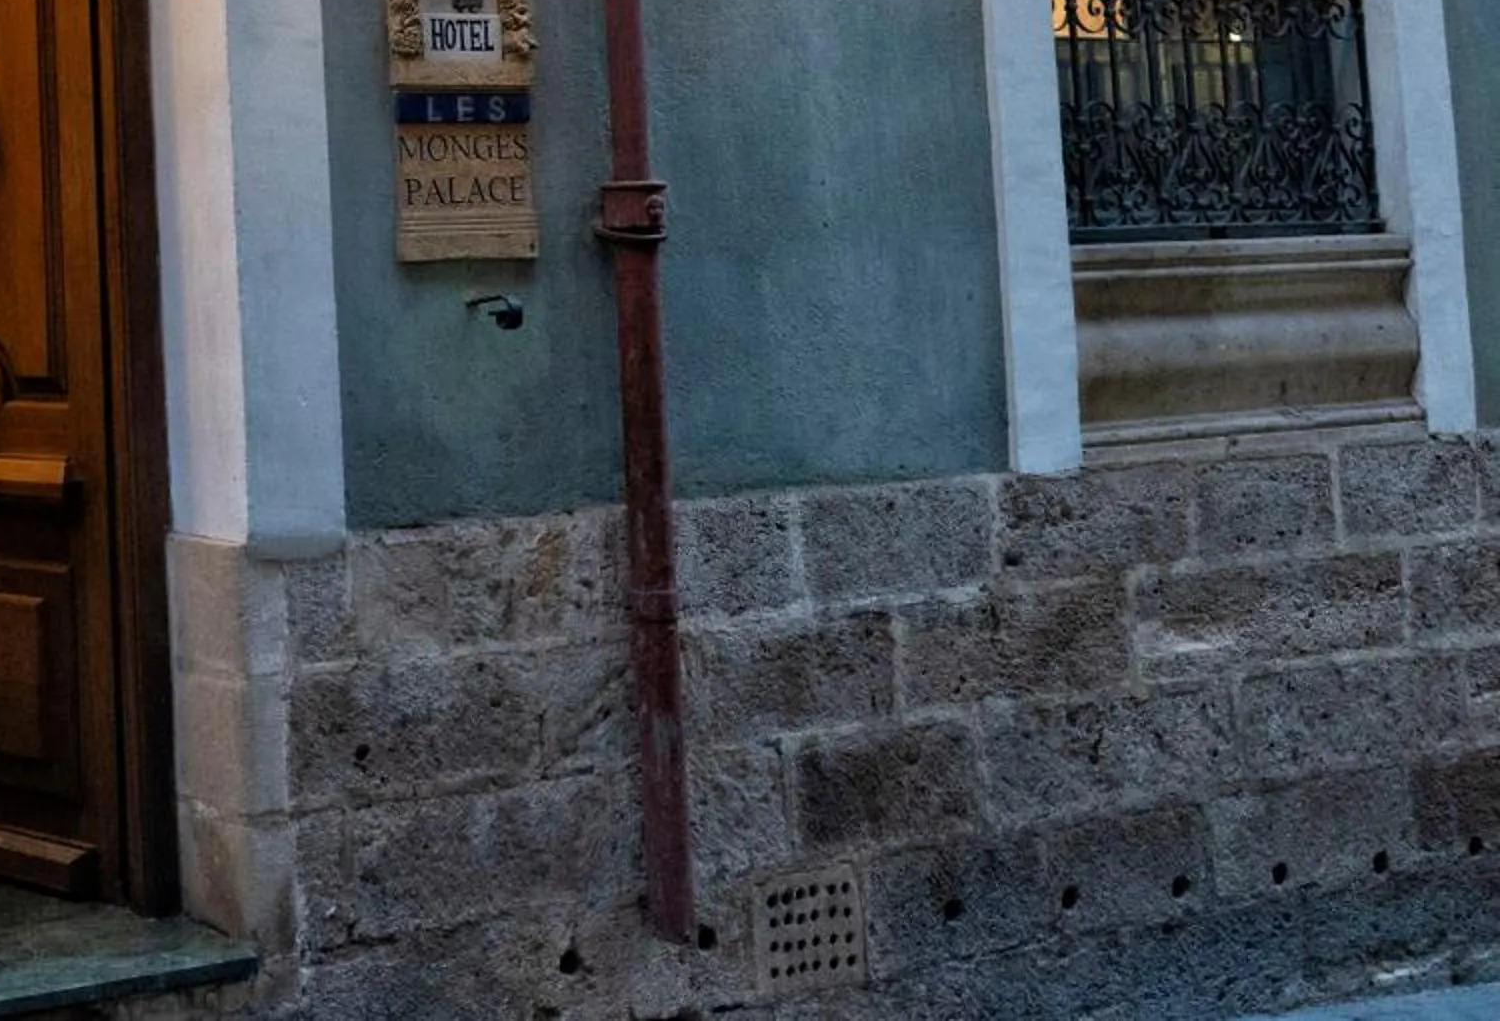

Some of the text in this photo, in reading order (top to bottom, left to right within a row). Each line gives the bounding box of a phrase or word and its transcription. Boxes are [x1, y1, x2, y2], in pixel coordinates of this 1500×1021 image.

[430, 18, 495, 52] HOTEL
[426, 96, 507, 122] LES
[399, 132, 529, 162] MONGES
[404, 175, 527, 206] PALACE
